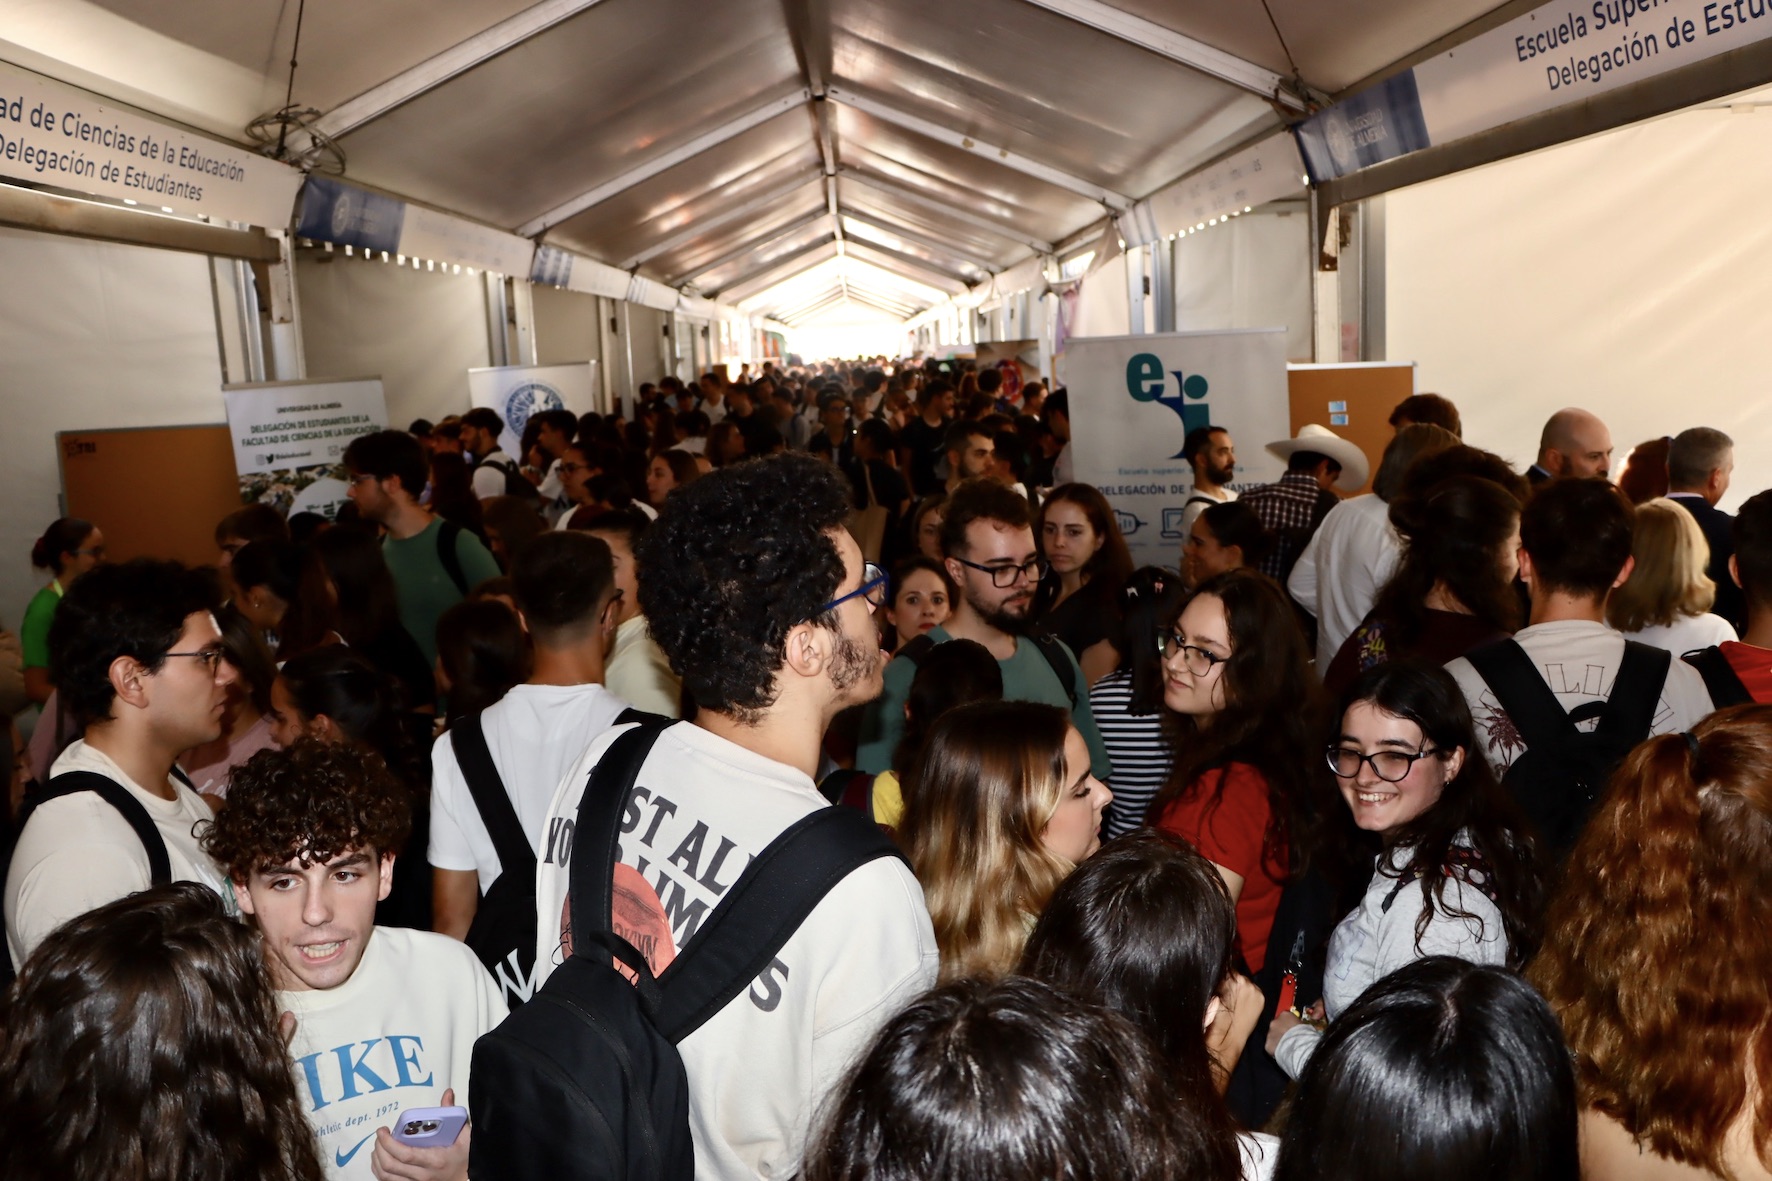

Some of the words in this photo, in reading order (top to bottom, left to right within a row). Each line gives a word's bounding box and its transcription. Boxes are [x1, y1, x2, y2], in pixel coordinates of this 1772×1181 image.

[1515, 12, 1588, 63] Escuela
[1546, 31, 1659, 91] Delegación
[1665, 16, 1696, 49] de
[30, 103, 56, 131] de
[62, 112, 136, 154] Ciencias
[139, 135, 159, 160] de
[163, 140, 175, 164] la
[179, 146, 244, 183] Educación
[100, 160, 120, 183] de
[124, 165, 204, 202] Estudiantes
[241, 434, 280, 447] FACULTAD
[280, 434, 290, 443] DE
[290, 429, 323, 442] CIENCIAS
[323, 428, 333, 438] DE
[333, 428, 342, 437] LA
[250, 420, 297, 434] DELEGACIÓN
[297, 420, 306, 429] DE
[307, 416, 351, 428] ESTUDIANTES
[352, 414, 361, 423] DE
[361, 414, 370, 423] LA
[1098, 483, 1166, 496] DELEGACIÓN
[1170, 484, 1185, 494] DE
[1118, 467, 1149, 476] Escuela
[667, 819, 757, 897] AL
[294, 1035, 434, 1113] IKE
[314, 1121, 342, 1138] thletic
[345, 1113, 372, 1128] dept.
[375, 1101, 400, 1118] 1972
